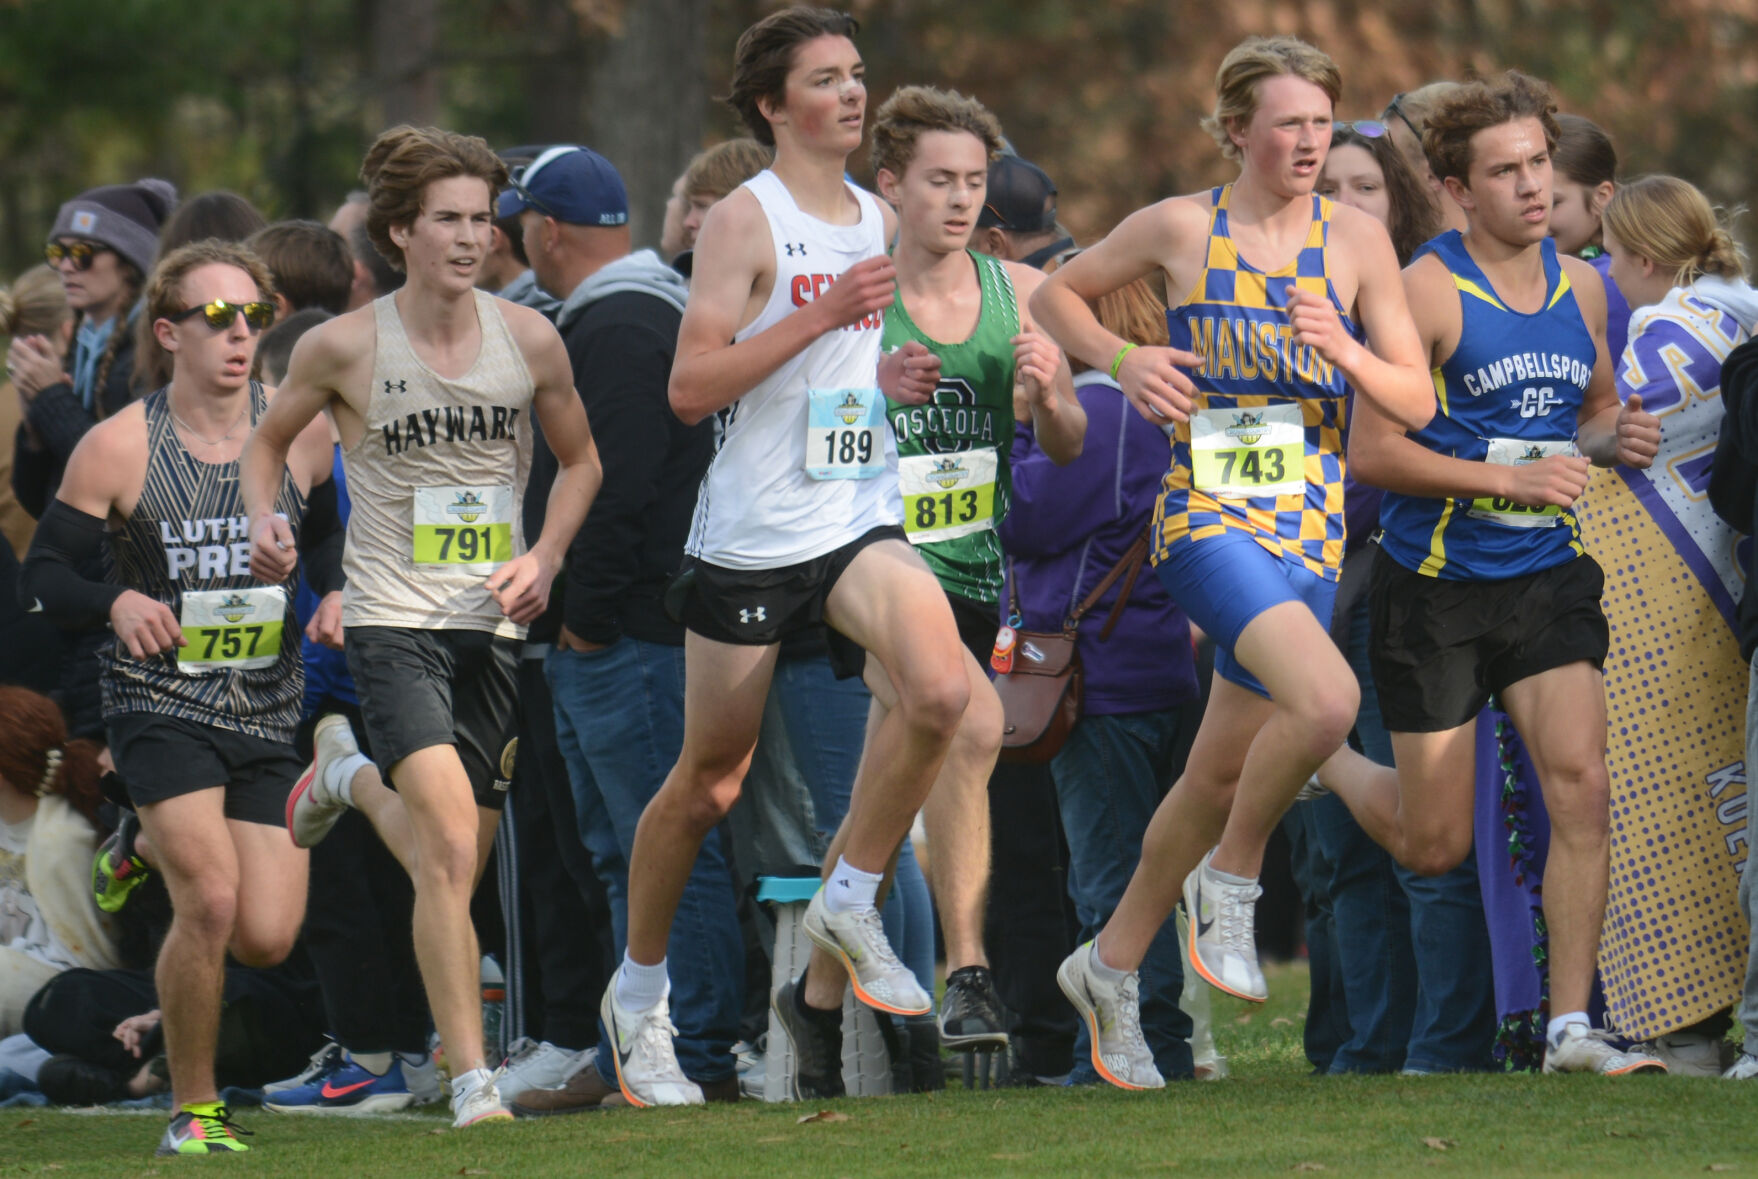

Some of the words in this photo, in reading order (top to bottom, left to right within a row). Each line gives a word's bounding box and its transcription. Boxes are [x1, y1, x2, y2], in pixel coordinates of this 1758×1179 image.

[1519, 387, 1554, 418] CC
[894, 407, 993, 443] OSCEOLA
[824, 429, 873, 465] 189
[1214, 448, 1286, 486] 743
[915, 490, 978, 529] 813
[434, 526, 492, 561] 791
[200, 625, 264, 659] 757
